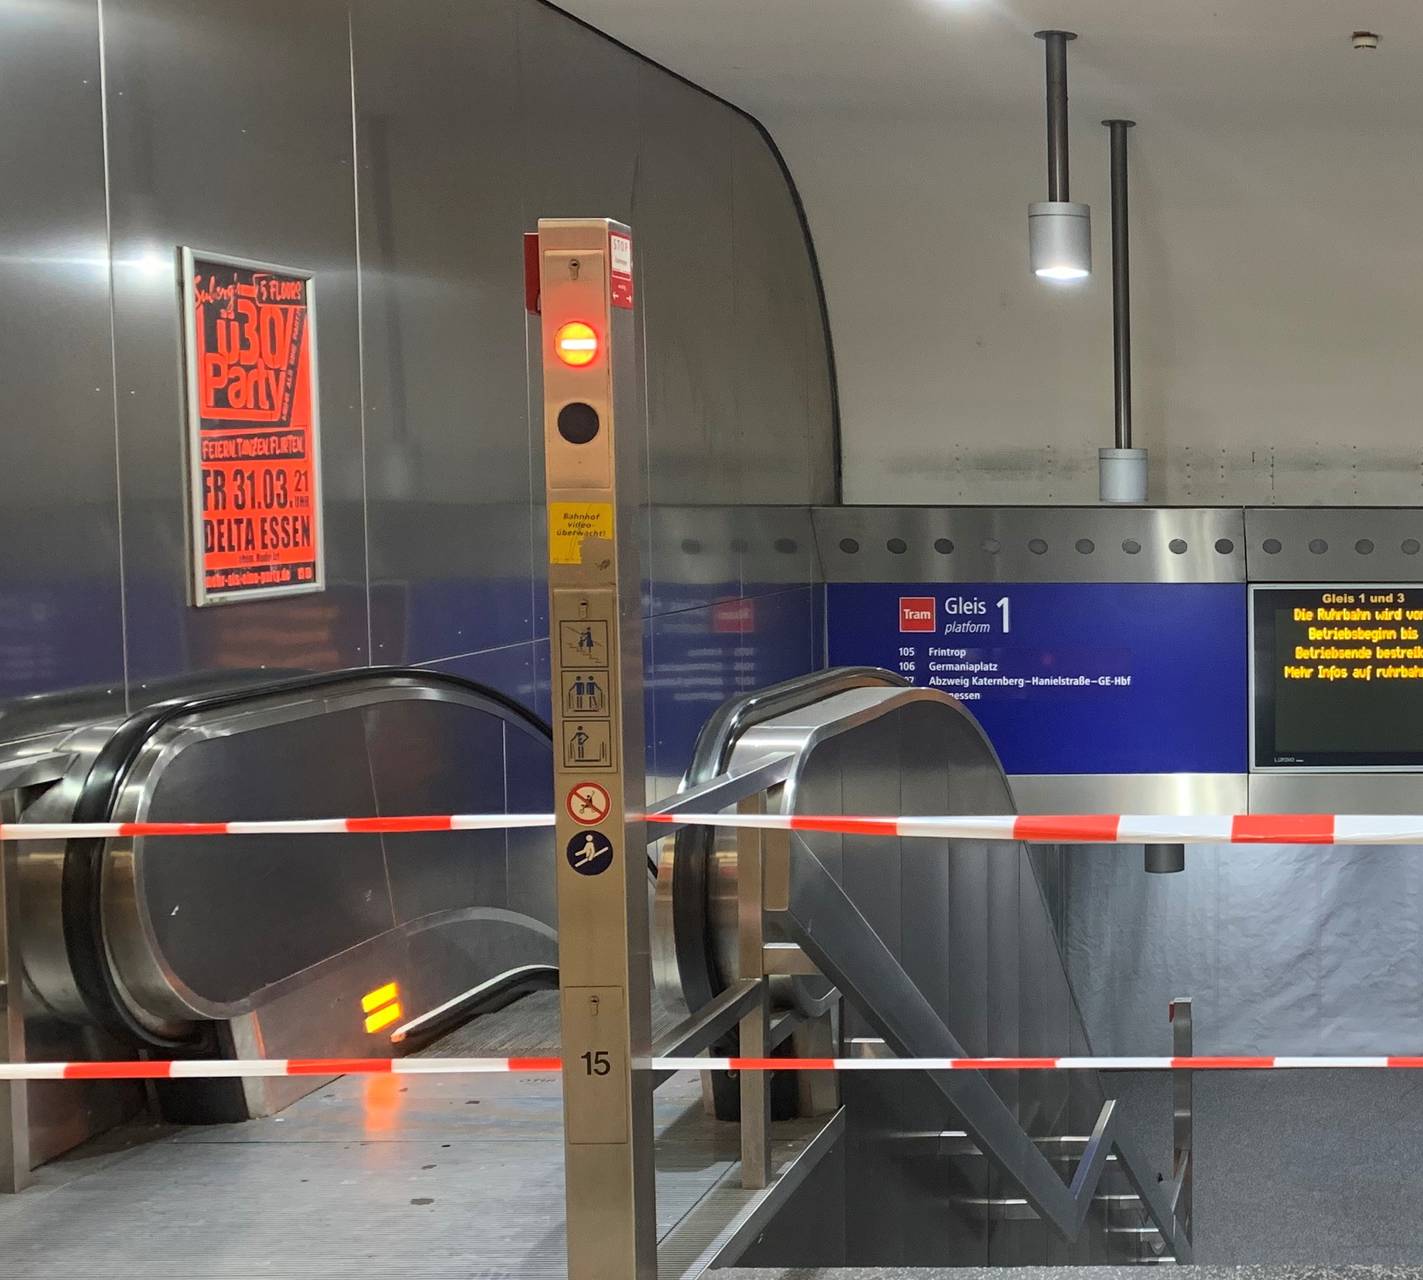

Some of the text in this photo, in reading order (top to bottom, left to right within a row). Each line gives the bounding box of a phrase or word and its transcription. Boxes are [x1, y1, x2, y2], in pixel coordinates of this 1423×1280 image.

[260, 280, 268, 301] 5
[205, 353, 286, 413] Party
[203, 469, 308, 511] FR 31.03. 21
[563, 512, 600, 521] Bahnhof
[204, 515, 310, 553] DELTA ESSEN
[556, 529, 606, 538] überwacht!
[1322, 593, 1405, 604] Gleis 1 und 3
[903, 609, 931, 620] Tram
[944, 596, 1010, 634] Gleis 1
[1293, 608, 1314, 621] Die
[1317, 608, 1371, 621] Ruhrbahn
[1375, 608, 1403, 621] wird
[944, 620, 991, 636] platform
[1308, 627, 1420, 643] Betriebsbeginn bis
[899, 647, 967, 659] 105 Frintrop
[1295, 646, 1373, 660] Betriebsende
[899, 661, 998, 674] 106 Germaniaplatz
[1284, 665, 1314, 679] Mehr
[1317, 665, 1348, 682] Infos
[1352, 665, 1373, 681] auf
[929, 676, 969, 688] Abzweig
[581, 1051, 611, 1076] 15
